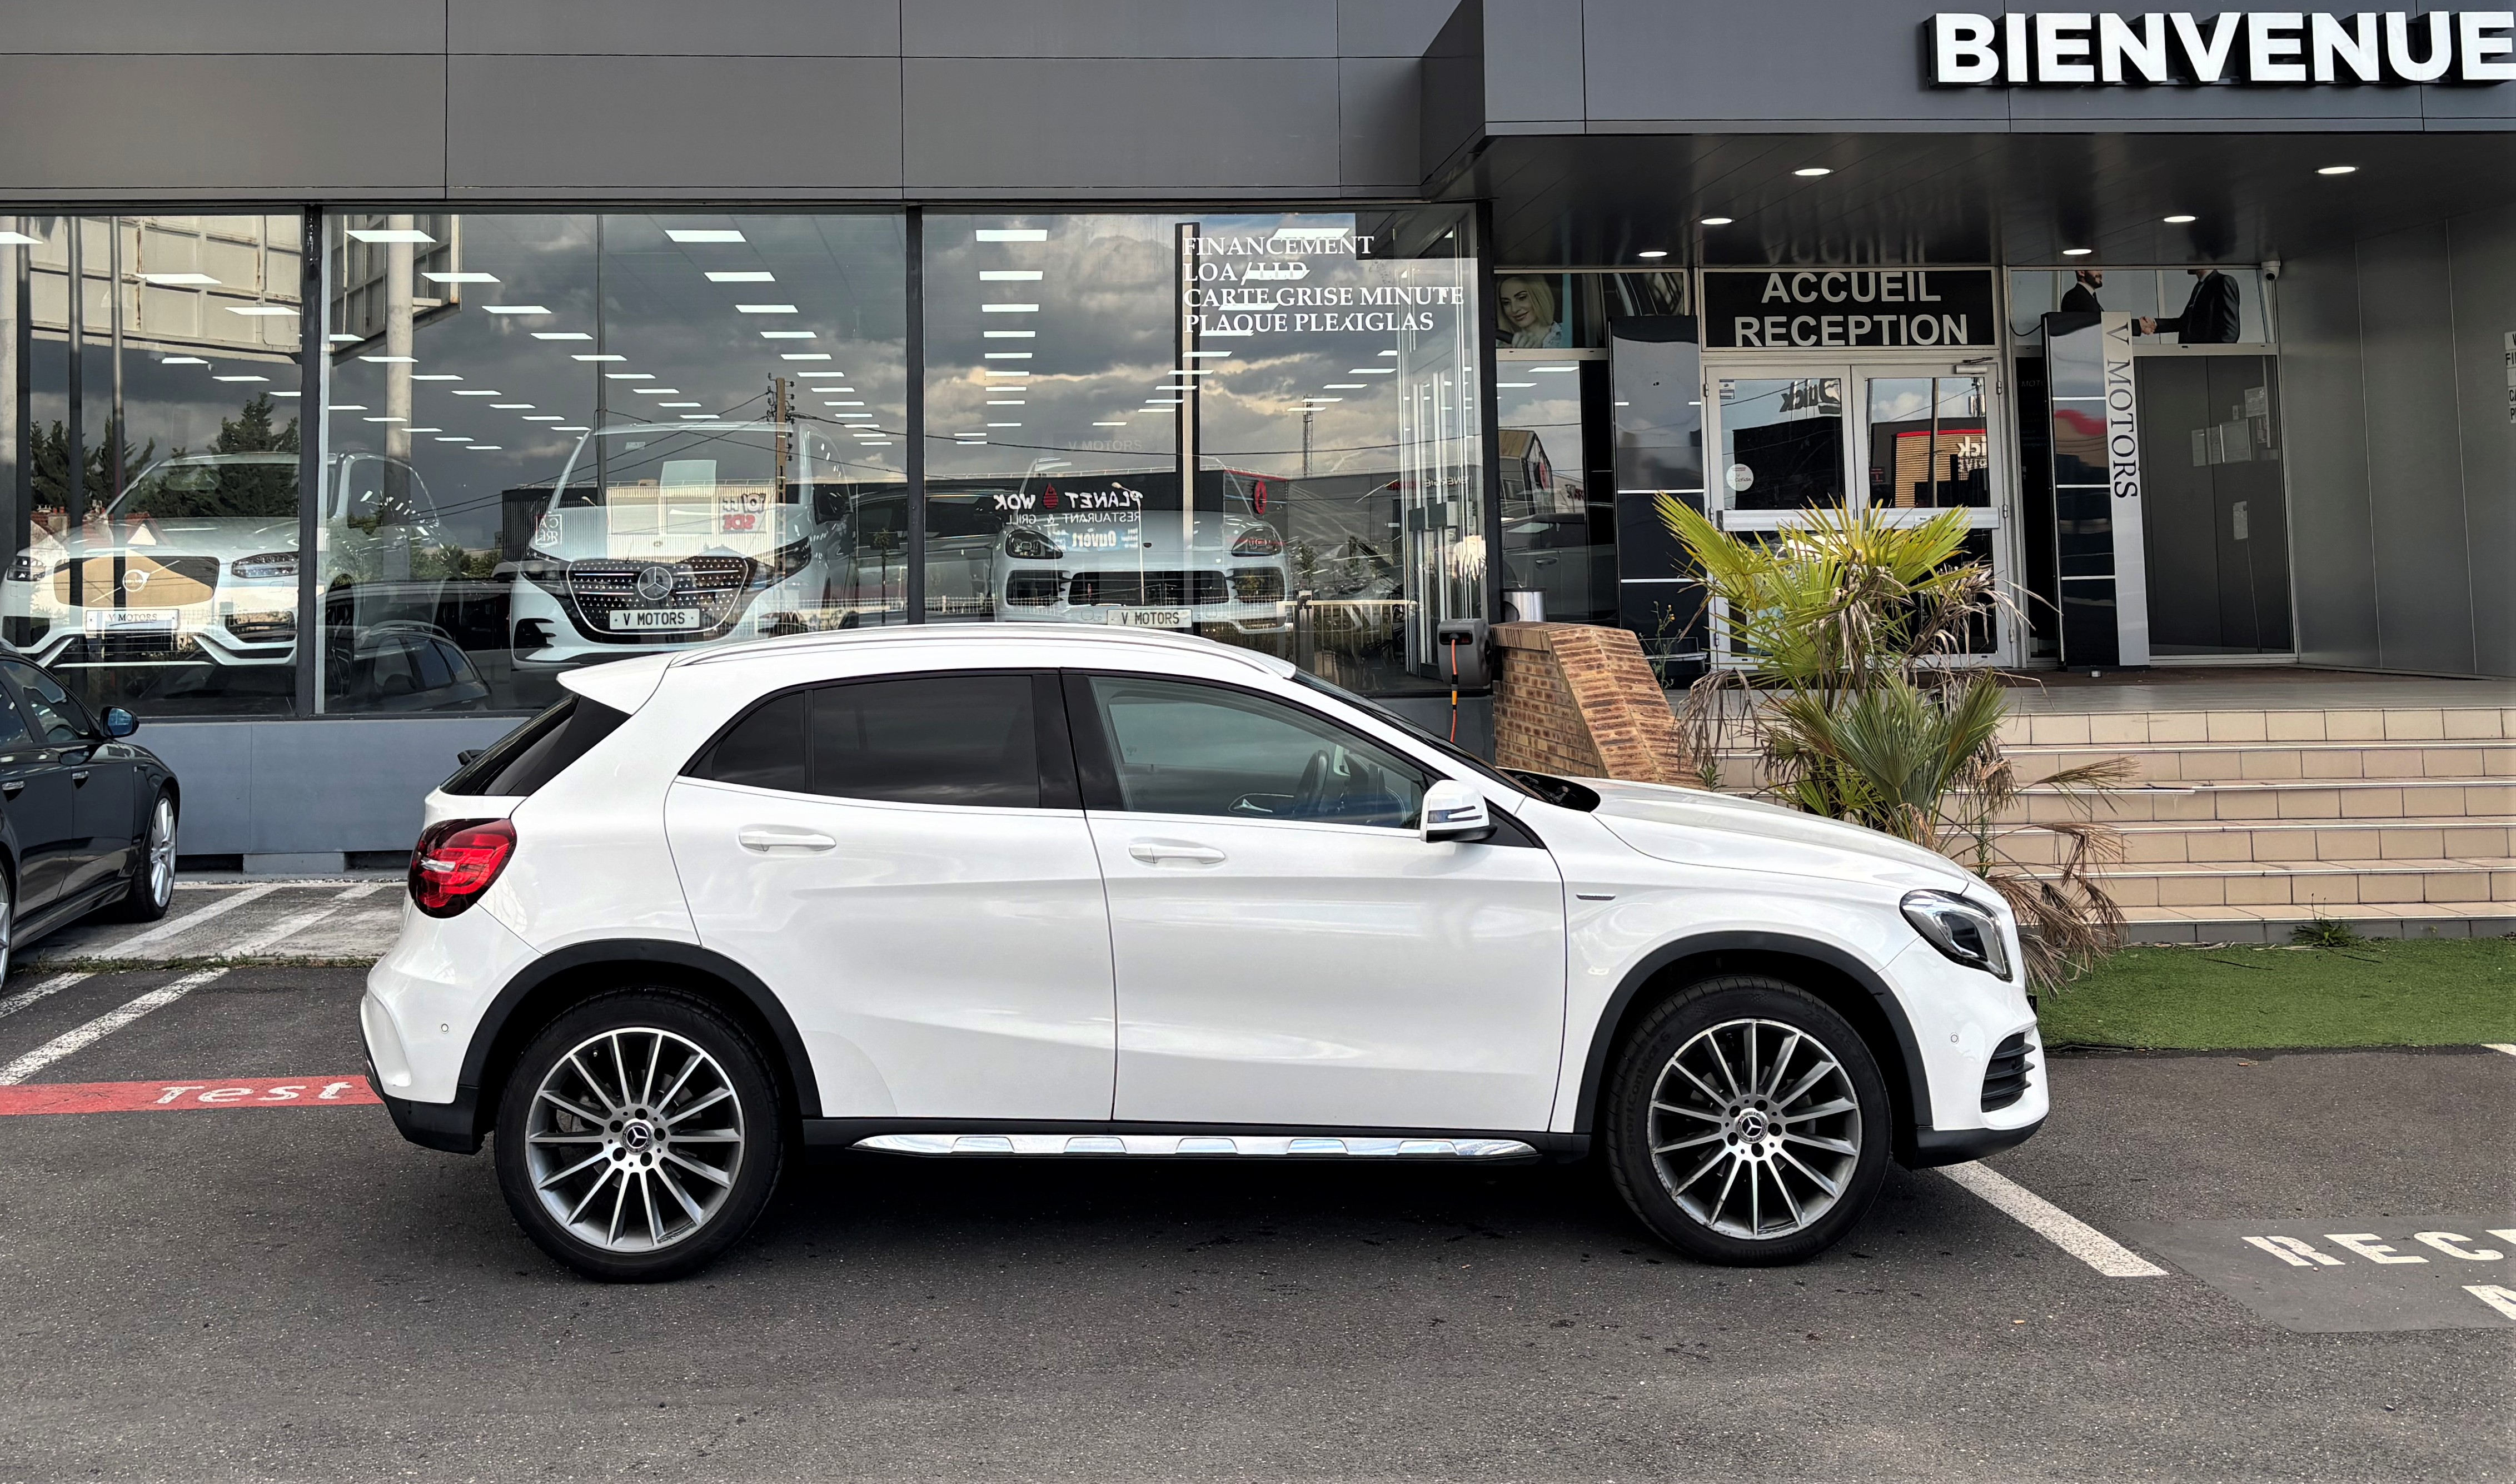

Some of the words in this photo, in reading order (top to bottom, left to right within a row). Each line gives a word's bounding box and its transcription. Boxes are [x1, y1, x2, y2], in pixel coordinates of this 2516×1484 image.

[1936, 11, 2516, 82] BIENVENUE
[1183, 236, 1374, 256] FINANCEMENT
[1184, 288, 1269, 307] CARTE
[1276, 287, 1353, 306] GRISE
[1359, 286, 1464, 305] MINUTE
[1761, 272, 1941, 303] ACCUEIL
[1184, 313, 1288, 333] PLAQUE
[1294, 312, 1434, 332] PLEXIGLAS
[1735, 314, 1968, 347] RECEPTION
[2106, 322, 2130, 346] V
[2108, 359, 2138, 498] MOTORS
[623, 613, 630, 626] V
[637, 612, 685, 625] MOTORS
[1122, 612, 1128, 625] V
[1135, 612, 1179, 625] MOTORS
[153, 1081, 353, 1105] Test
